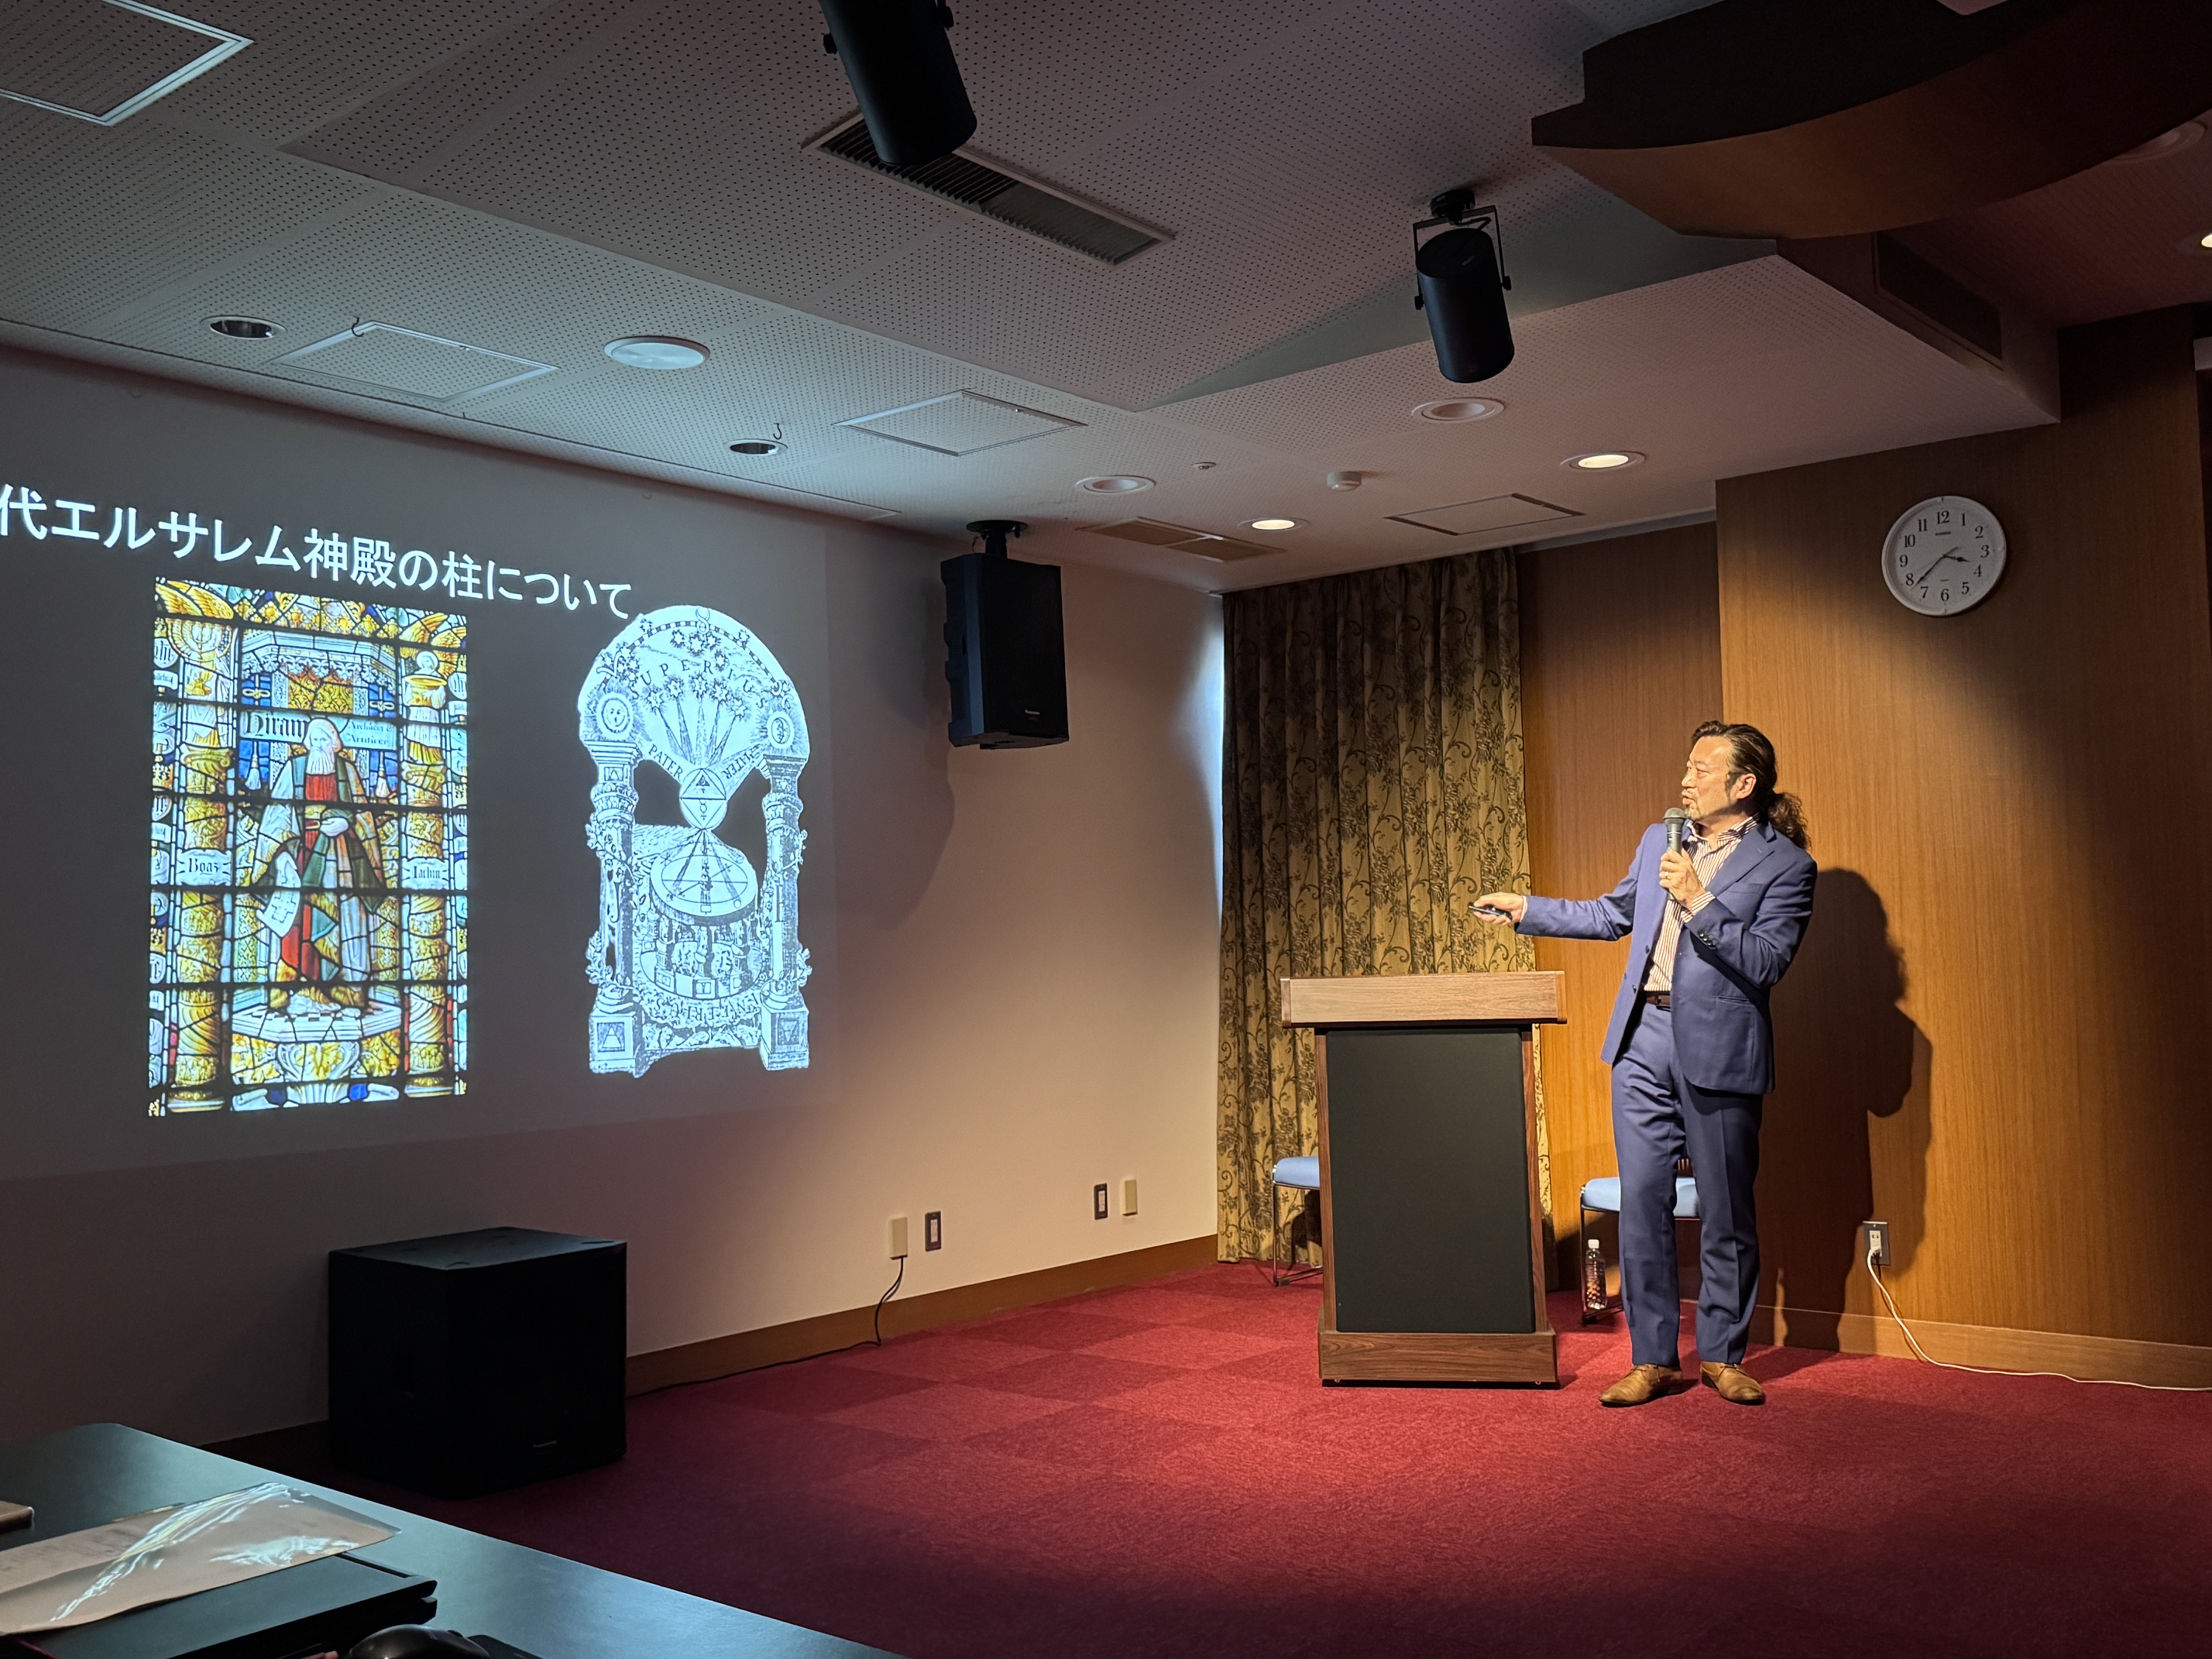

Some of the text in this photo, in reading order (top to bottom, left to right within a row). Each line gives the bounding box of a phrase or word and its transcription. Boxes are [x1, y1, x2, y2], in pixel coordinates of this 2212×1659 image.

[1937, 510, 1950, 524] 12
[1962, 513, 1966, 527] 1
[1918, 518, 1928, 532] 11
[1975, 525, 1984, 539] 2
[1905, 534, 1915, 548] 10
[0, 483, 633, 620] 代エルサレム神殿の柱について
[1980, 544, 1990, 558] 3
[1899, 554, 1908, 568] 9
[1973, 564, 1983, 577] 4
[1905, 572, 1914, 586] 8
[1920, 586, 1929, 599] 7
[1940, 588, 1949, 602] 6
[1961, 581, 1970, 595] 5
[648, 744, 683, 781] PATER
